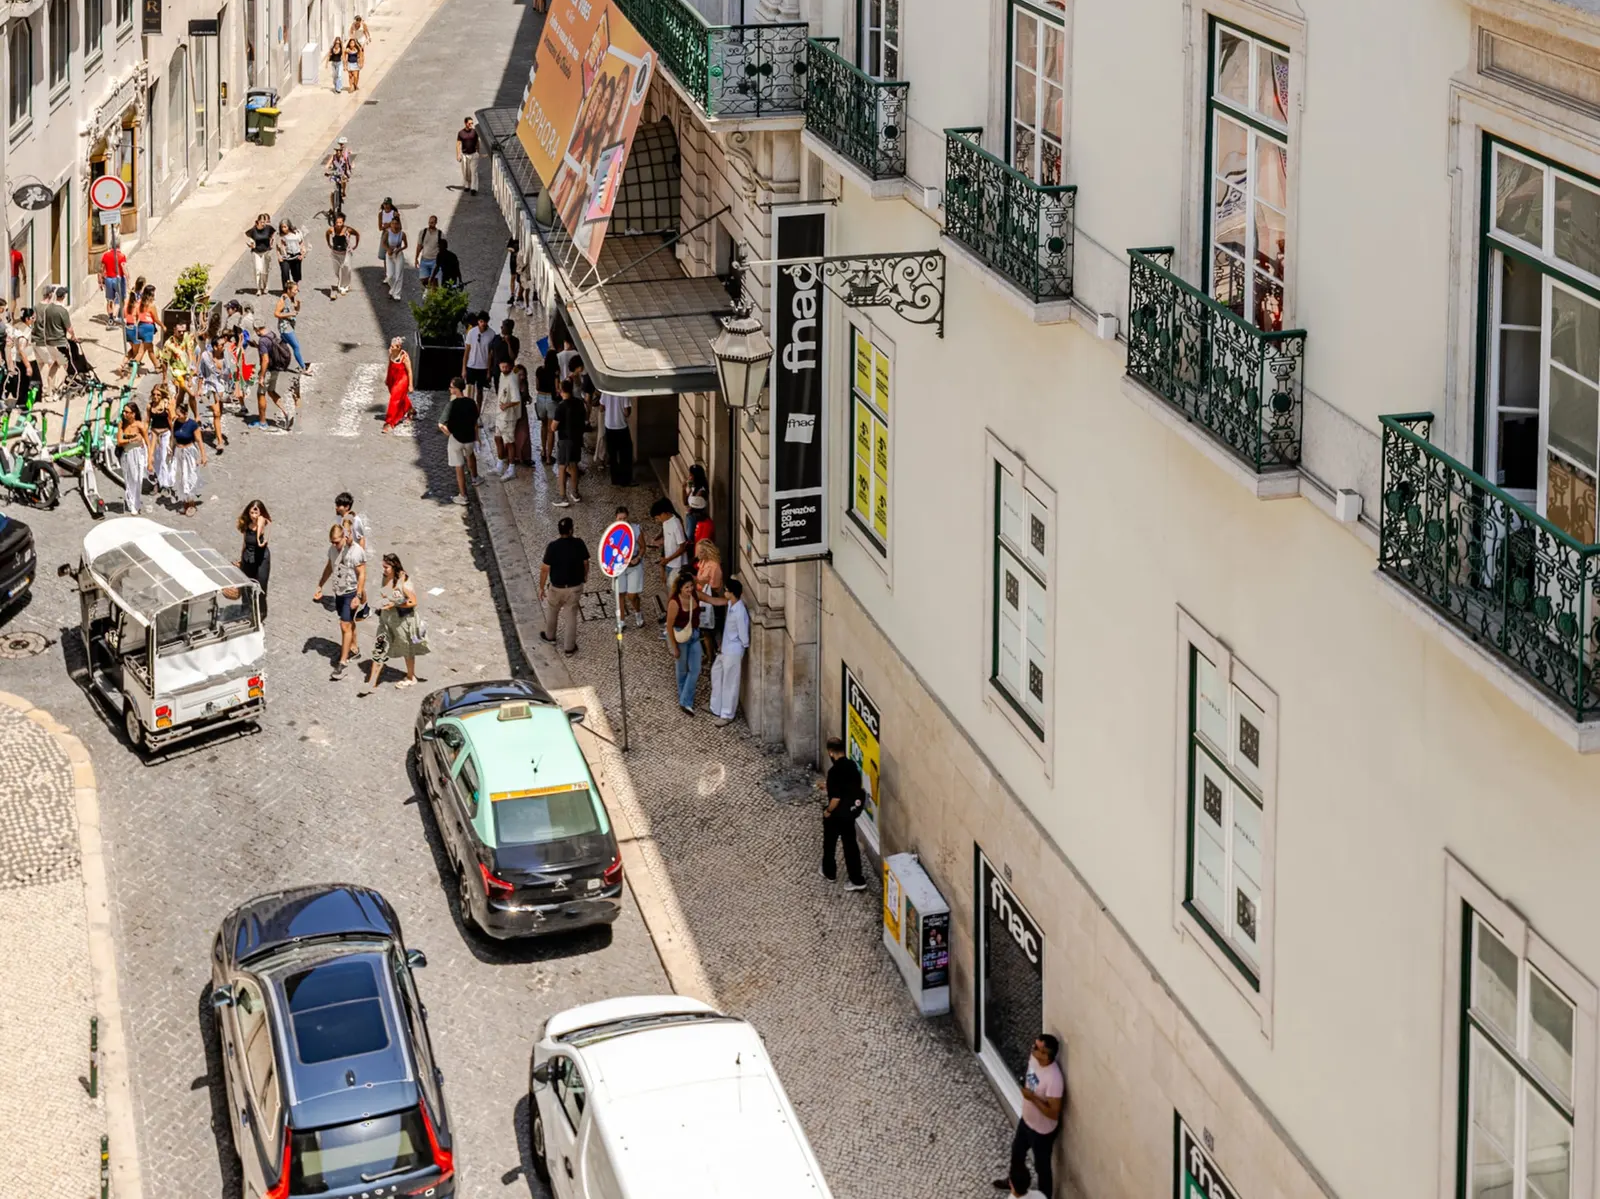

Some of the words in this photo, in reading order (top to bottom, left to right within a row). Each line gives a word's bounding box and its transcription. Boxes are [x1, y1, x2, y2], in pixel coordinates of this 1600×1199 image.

[525, 96, 560, 162] SEPHORA
[782, 259, 817, 374] fnac
[786, 418, 815, 428] fnac
[781, 515, 792, 523] DO
[851, 684, 878, 736] fnac
[990, 877, 1037, 964] fnac
